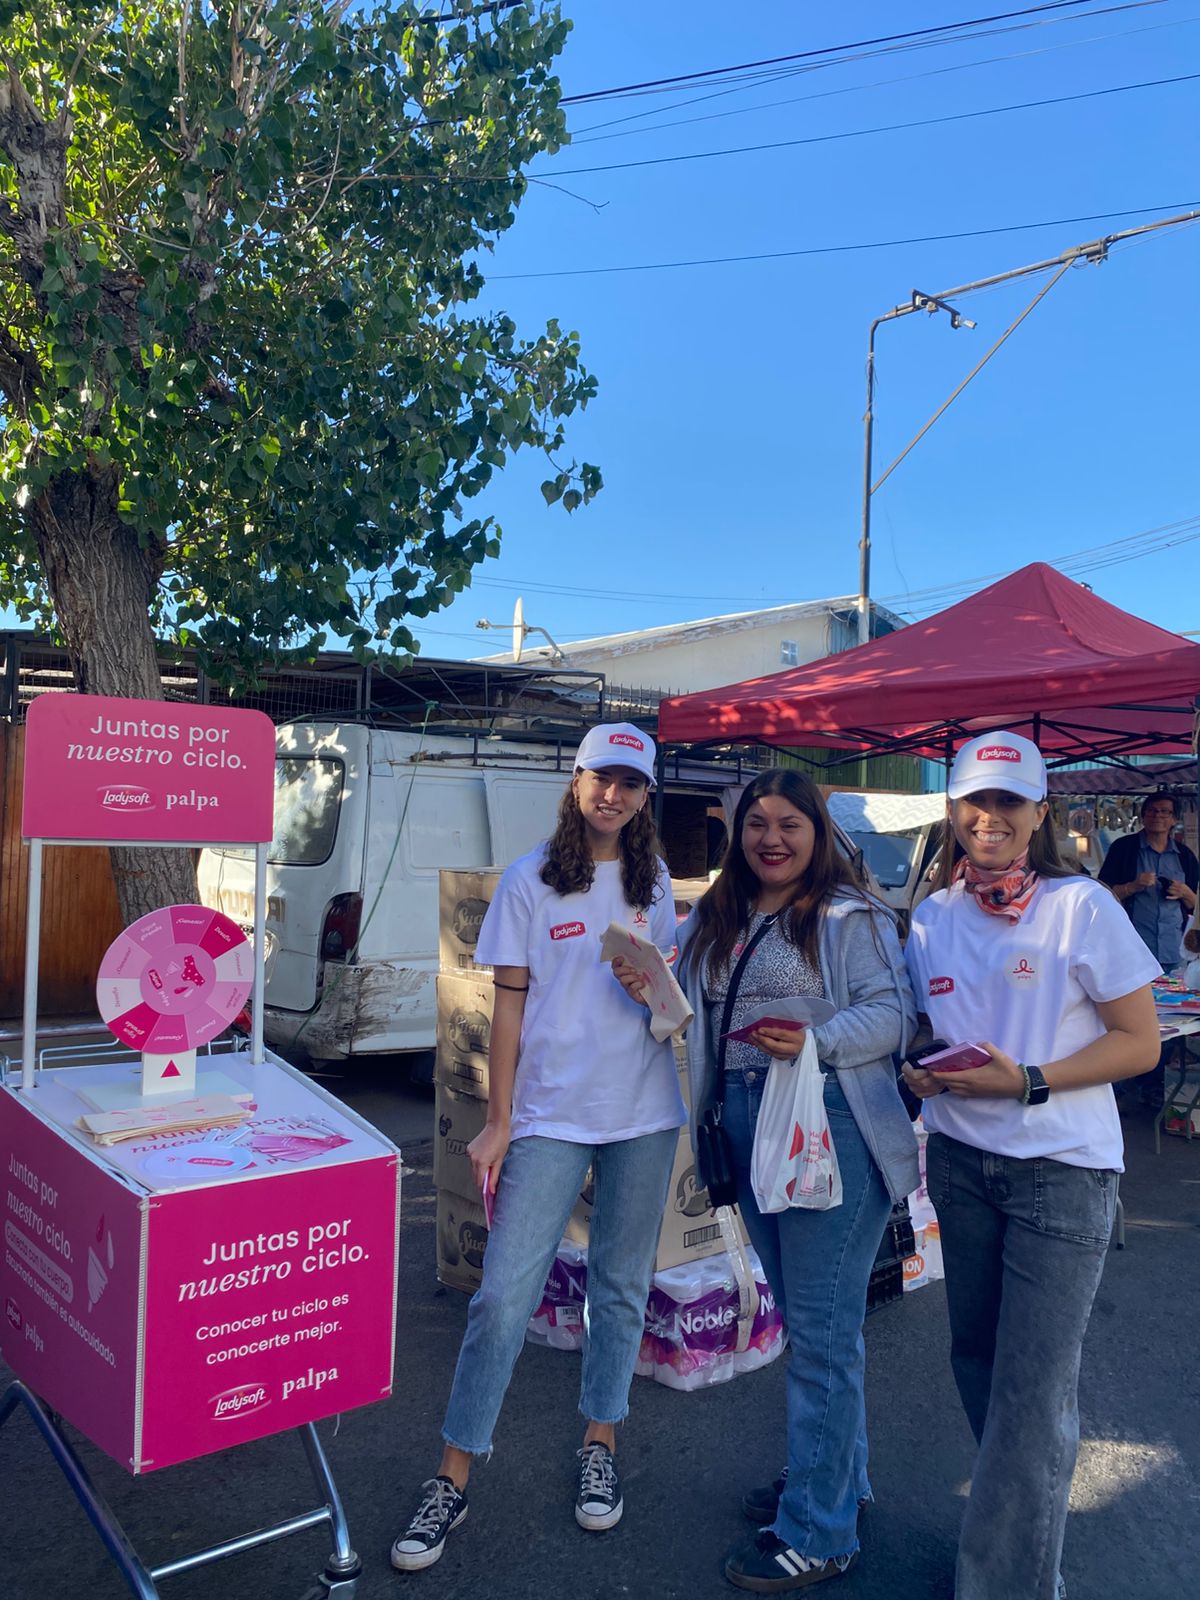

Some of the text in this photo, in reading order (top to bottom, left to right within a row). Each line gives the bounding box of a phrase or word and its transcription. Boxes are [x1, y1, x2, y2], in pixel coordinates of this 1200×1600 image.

[90, 716, 230, 747] Juntas por
[981, 748, 1018, 759] Ladysoft
[67, 743, 247, 769] nuestro ciclo.
[103, 790, 219, 811] Ladysoft palpa
[554, 923, 582, 939] Ladysoft
[9, 1152, 59, 1209] Juntas por
[7, 1190, 74, 1264] nuestro ciclo.
[202, 1219, 352, 1265] Juntas por
[178, 1244, 369, 1302] nuestro ciclo.
[25, 1322, 44, 1353] palpa
[196, 1293, 349, 1340] Conocer tu ciclo es
[674, 1306, 737, 1335] Noble
[68, 1314, 117, 1369] autocuidado.
[206, 1320, 342, 1365] conocerte mejor.
[214, 1367, 338, 1417] Ladysoft palpa
